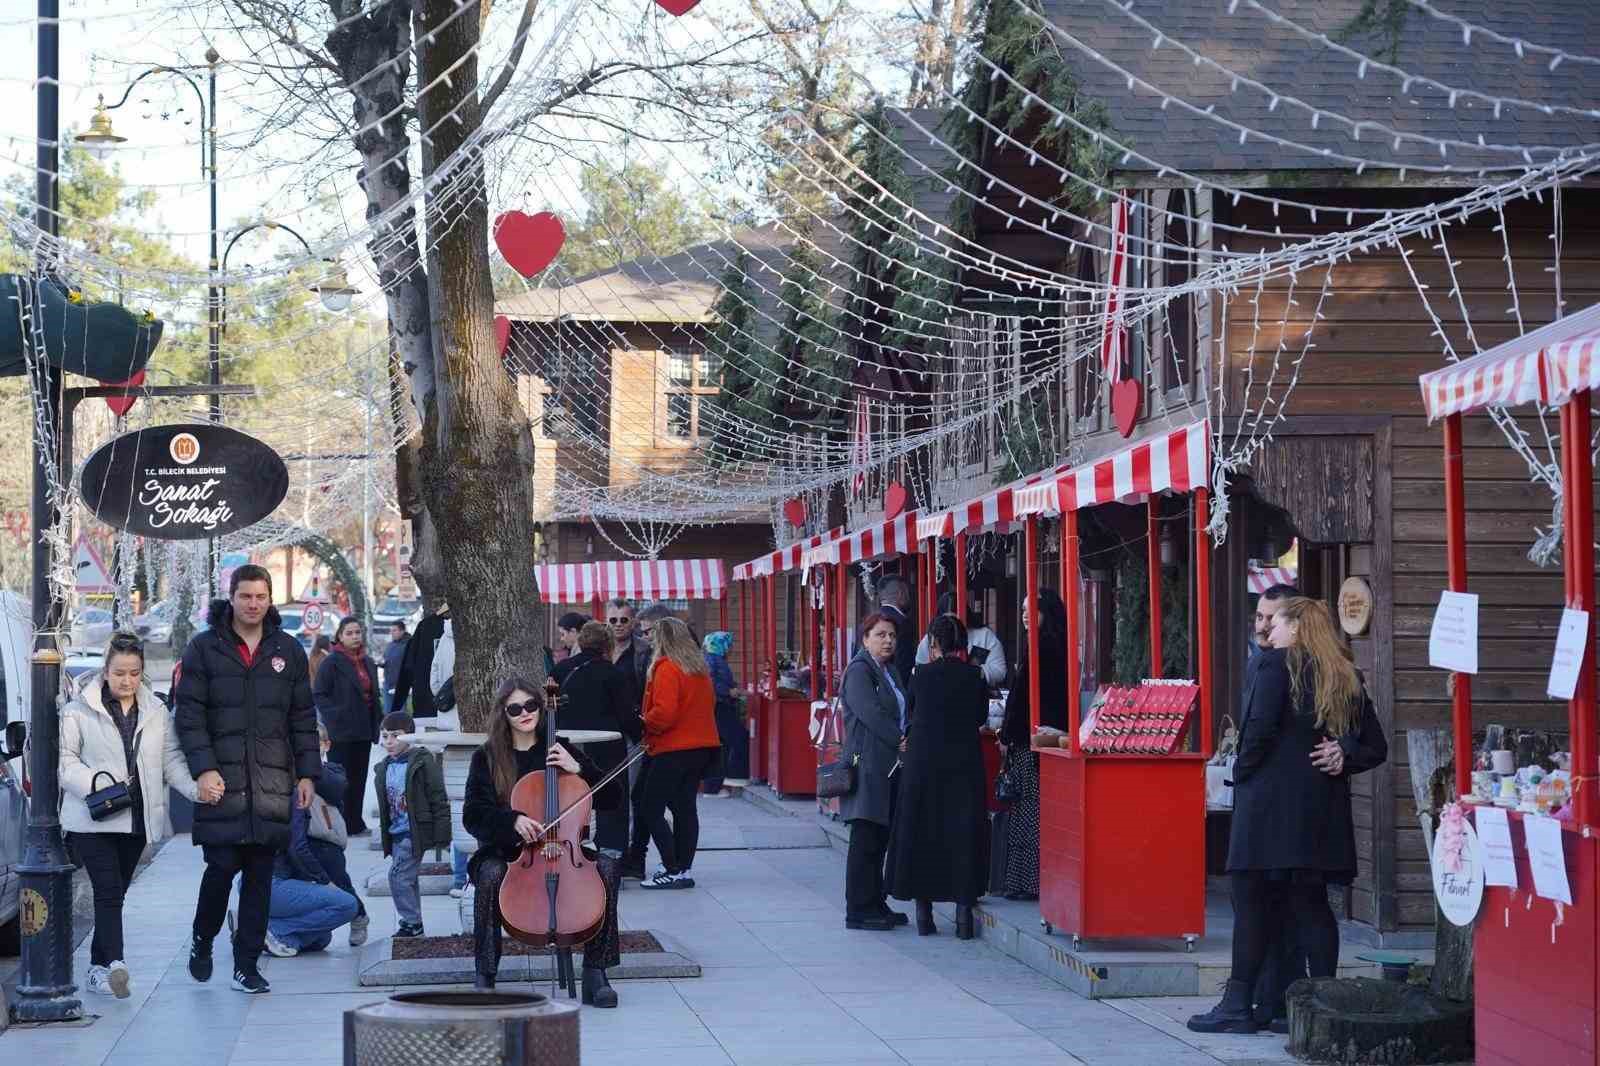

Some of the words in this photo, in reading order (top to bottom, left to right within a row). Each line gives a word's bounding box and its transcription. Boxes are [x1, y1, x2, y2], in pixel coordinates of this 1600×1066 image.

[144, 468, 157, 476] T.C.
[158, 466, 185, 475] BİLECİK
[186, 465, 226, 475] BELEDİYESİ
[139, 478, 220, 506] Sanat
[149, 500, 234, 530] Sokağı
[307, 611, 320, 624] 50
